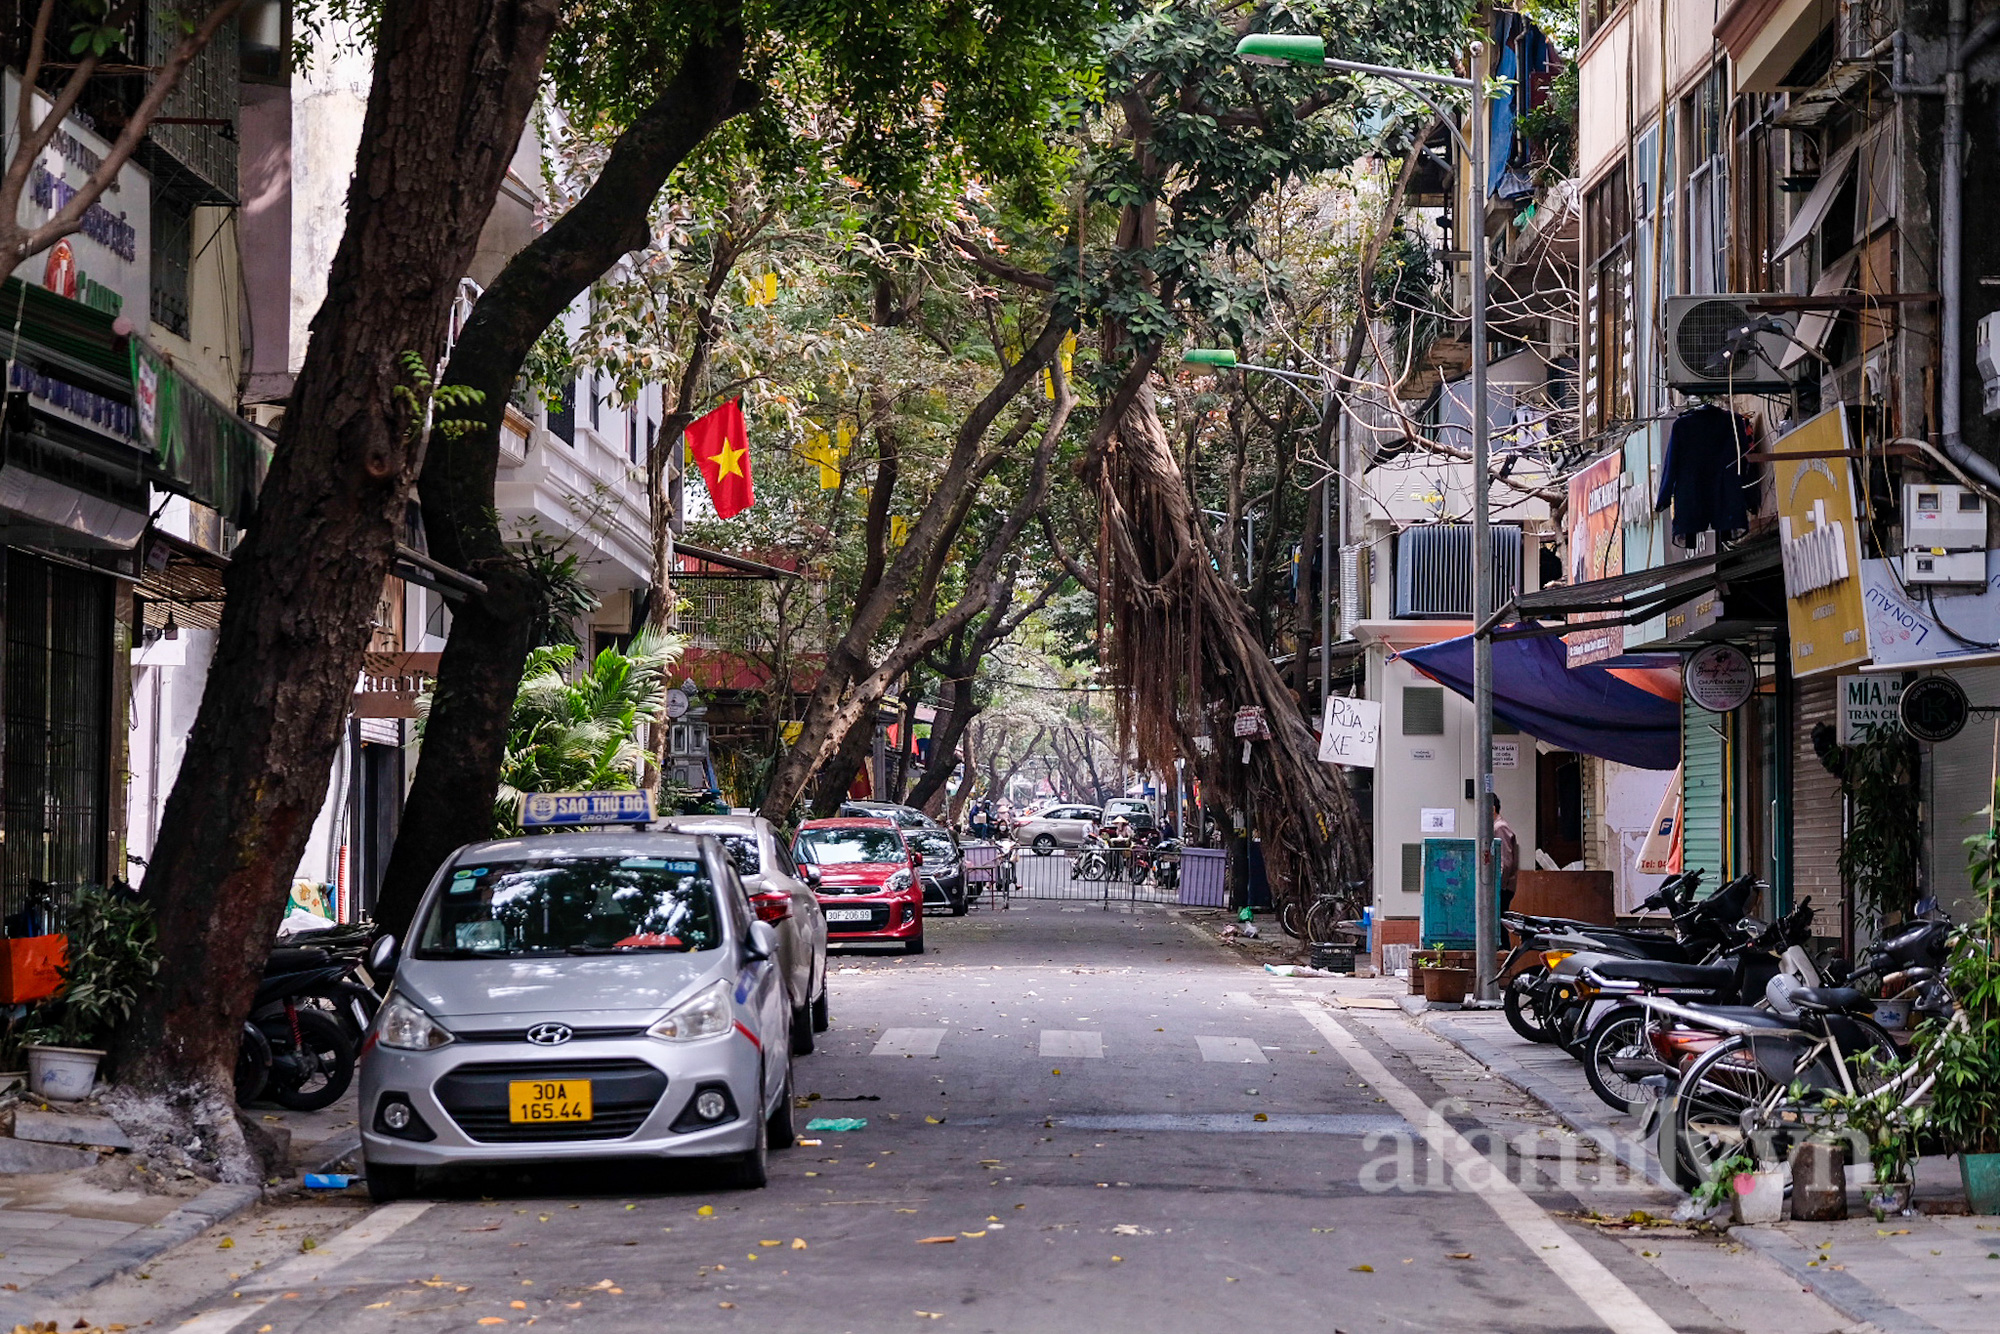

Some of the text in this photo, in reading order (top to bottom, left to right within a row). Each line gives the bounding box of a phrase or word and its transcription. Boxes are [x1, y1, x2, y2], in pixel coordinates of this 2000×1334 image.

[1848, 678, 1883, 705] MÍA
[1331, 698, 1362, 728] RỬA
[1881, 709, 1900, 720] CH
[1327, 732, 1353, 756] XE
[557, 797, 589, 814] SAO
[580, 813, 619, 821] GROUP
[1641, 860, 1655, 868] Tel:
[533, 1083, 567, 1100] 30A
[521, 1102, 582, 1120] 165.44
